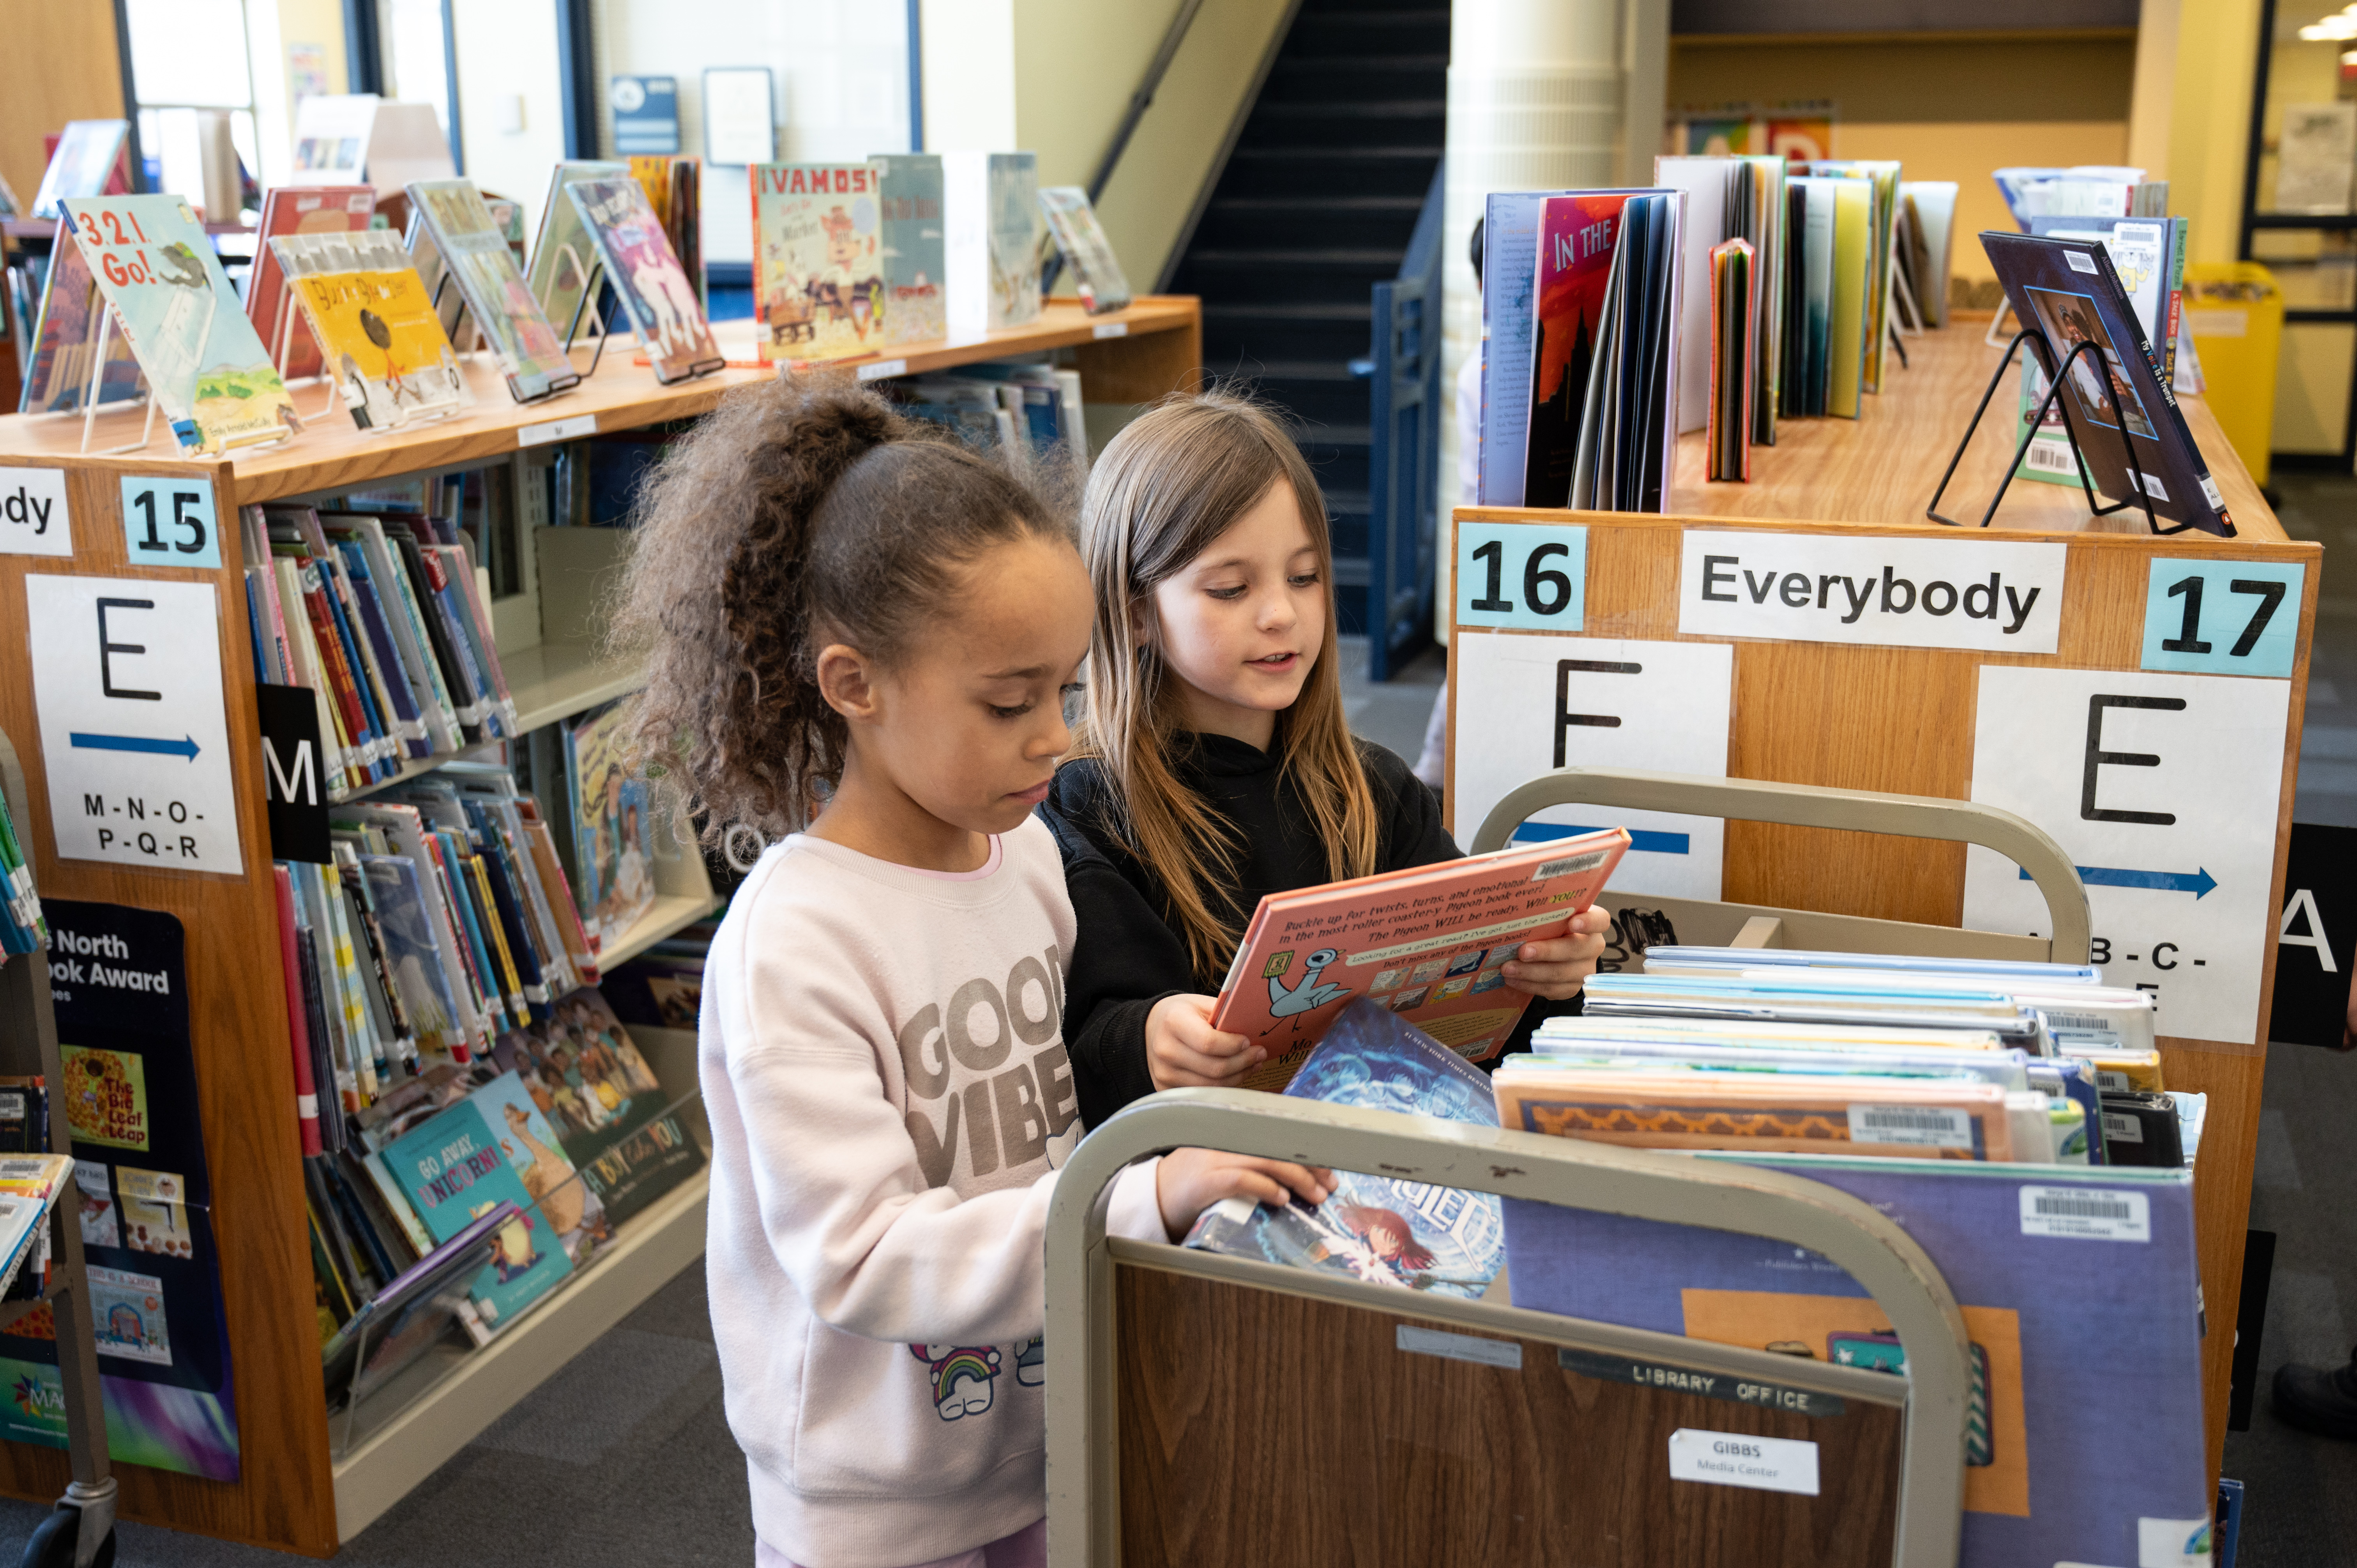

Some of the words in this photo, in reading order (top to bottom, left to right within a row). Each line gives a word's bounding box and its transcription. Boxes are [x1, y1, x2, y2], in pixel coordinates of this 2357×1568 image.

[761, 169, 878, 193] ¡VAMOS!
[102, 250, 157, 288] Go!
[1554, 232, 1575, 273] IN
[1580, 219, 1611, 258] THE
[2101, 256, 2124, 300] Allen/Johnson
[2141, 340, 2150, 351] My
[2146, 351, 2158, 369] Voice
[2159, 380, 2177, 408] Trumpet
[133, 489, 206, 554] 15
[1470, 540, 1572, 616] 16
[1701, 553, 2042, 634] Everybody
[2161, 576, 2288, 657] 17
[97, 598, 162, 701] E
[261, 736, 318, 807] M
[2080, 694, 2187, 826] E
[1285, 917, 1323, 932] Buckle
[1327, 915, 1342, 925] up
[1346, 910, 1366, 920] for
[1369, 902, 1408, 916] twists,
[1412, 894, 1444, 908] turns,
[1449, 888, 1470, 901] and
[1473, 876, 1529, 895] emotional
[1295, 930, 1314, 941] the
[1318, 923, 1348, 938] most
[1352, 918, 1384, 931] roller
[1445, 898, 1482, 913] Pigeon
[1485, 893, 1512, 905] book
[1515, 883, 1545, 899] ever!
[1368, 931, 1389, 943] The
[1393, 923, 1430, 937] Pigeon
[1435, 914, 1464, 930] WILL
[1468, 911, 1482, 921] be
[1485, 904, 1519, 918] ready.
[1526, 896, 1549, 910] Will
[56, 929, 129, 960] North
[1352, 952, 1387, 963] Looking
[1389, 947, 1405, 955] for
[1413, 940, 1439, 952] great
[1488, 926, 1502, 935] got
[1524, 918, 1538, 926] the
[1540, 910, 1568, 922] ticket!
[1383, 957, 1406, 968] Don't
[1408, 954, 1427, 964] miss
[1429, 950, 1446, 959] any
[1448, 945, 1459, 954] of
[1460, 943, 1474, 952] the
[1475, 938, 1502, 949] Pigeon
[1504, 930, 1532, 942] books!
[2279, 888, 2338, 972] A
[90, 962, 170, 995] Award
[1278, 1049, 1309, 1066] Will
[1290, 1038, 1312, 1052] Mo
[1412, 1036, 1429, 1049] NEW
[1429, 1047, 1447, 1062] YORK
[1447, 1060, 1467, 1076] TIMES
[1467, 1074, 1493, 1094] BESTSEL
[104, 1077, 134, 1095] The
[108, 1093, 134, 1114] Big
[108, 1110, 143, 1127] Leaf
[108, 1126, 146, 1144] Leap
[647, 1118, 684, 1154] YOU
[417, 1155, 441, 1180] GO
[440, 1133, 481, 1168] AWAY,
[1633, 1365, 1716, 1394] LIBRARY
[1737, 1383, 1810, 1411] OFFICE
[1697, 1458, 1735, 1473] Media
[1738, 1462, 1781, 1478] Center
[1713, 1440, 1762, 1458] GIBBS
